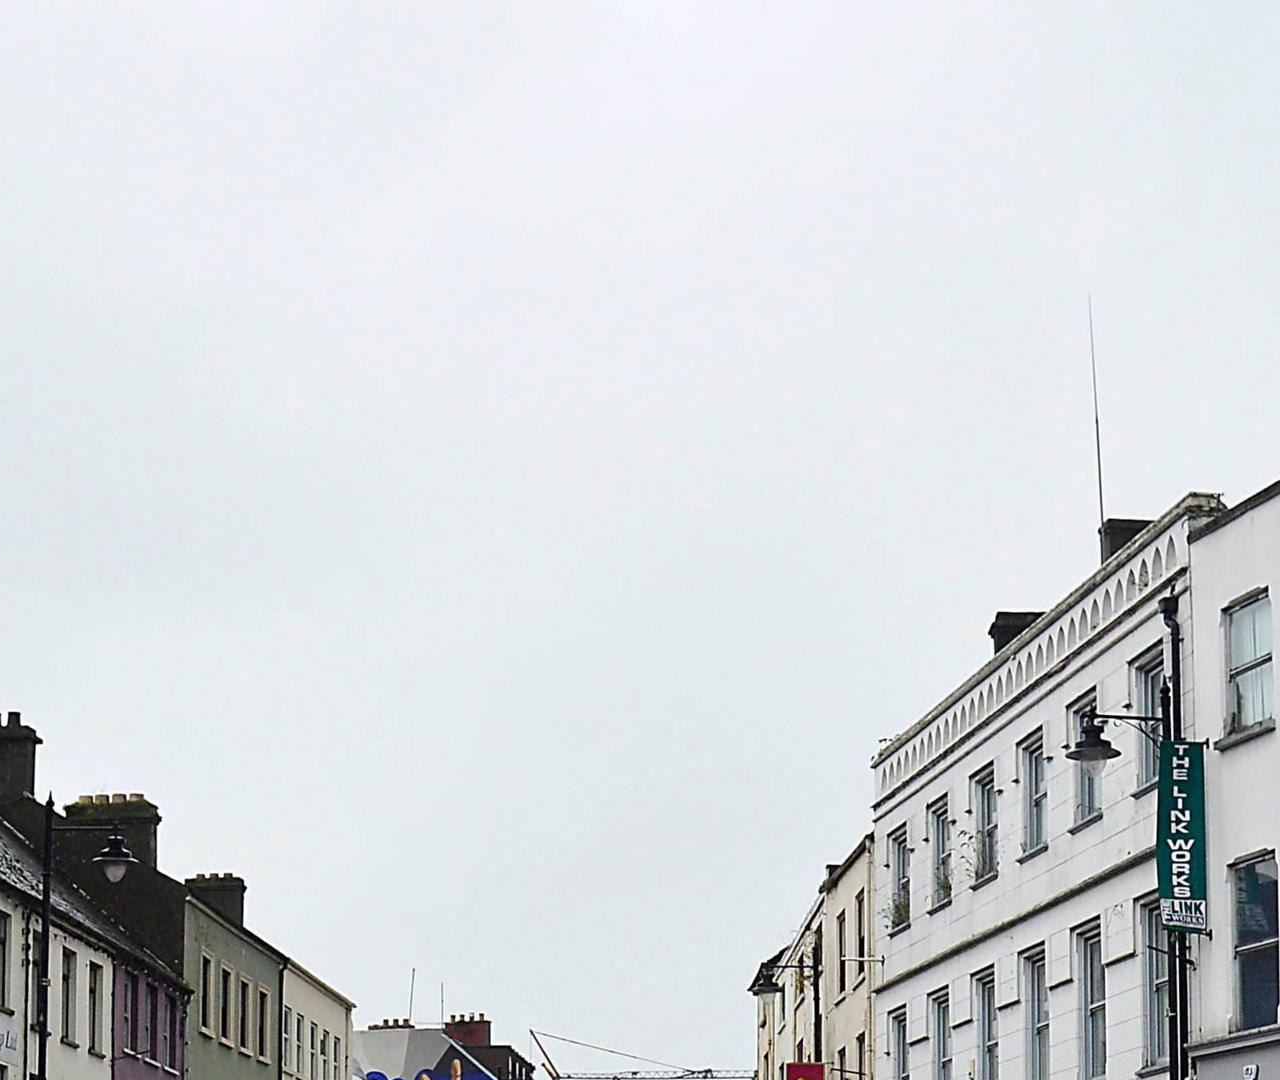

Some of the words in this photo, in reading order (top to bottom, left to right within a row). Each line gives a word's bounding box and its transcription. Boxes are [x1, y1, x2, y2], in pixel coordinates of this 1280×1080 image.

[1172, 744, 1190, 780] THE
[1170, 785, 1191, 834] LINK
[1166, 838, 1196, 898] WORKS
[1171, 900, 1204, 916] LINK
[1172, 914, 1205, 926] WORKS
